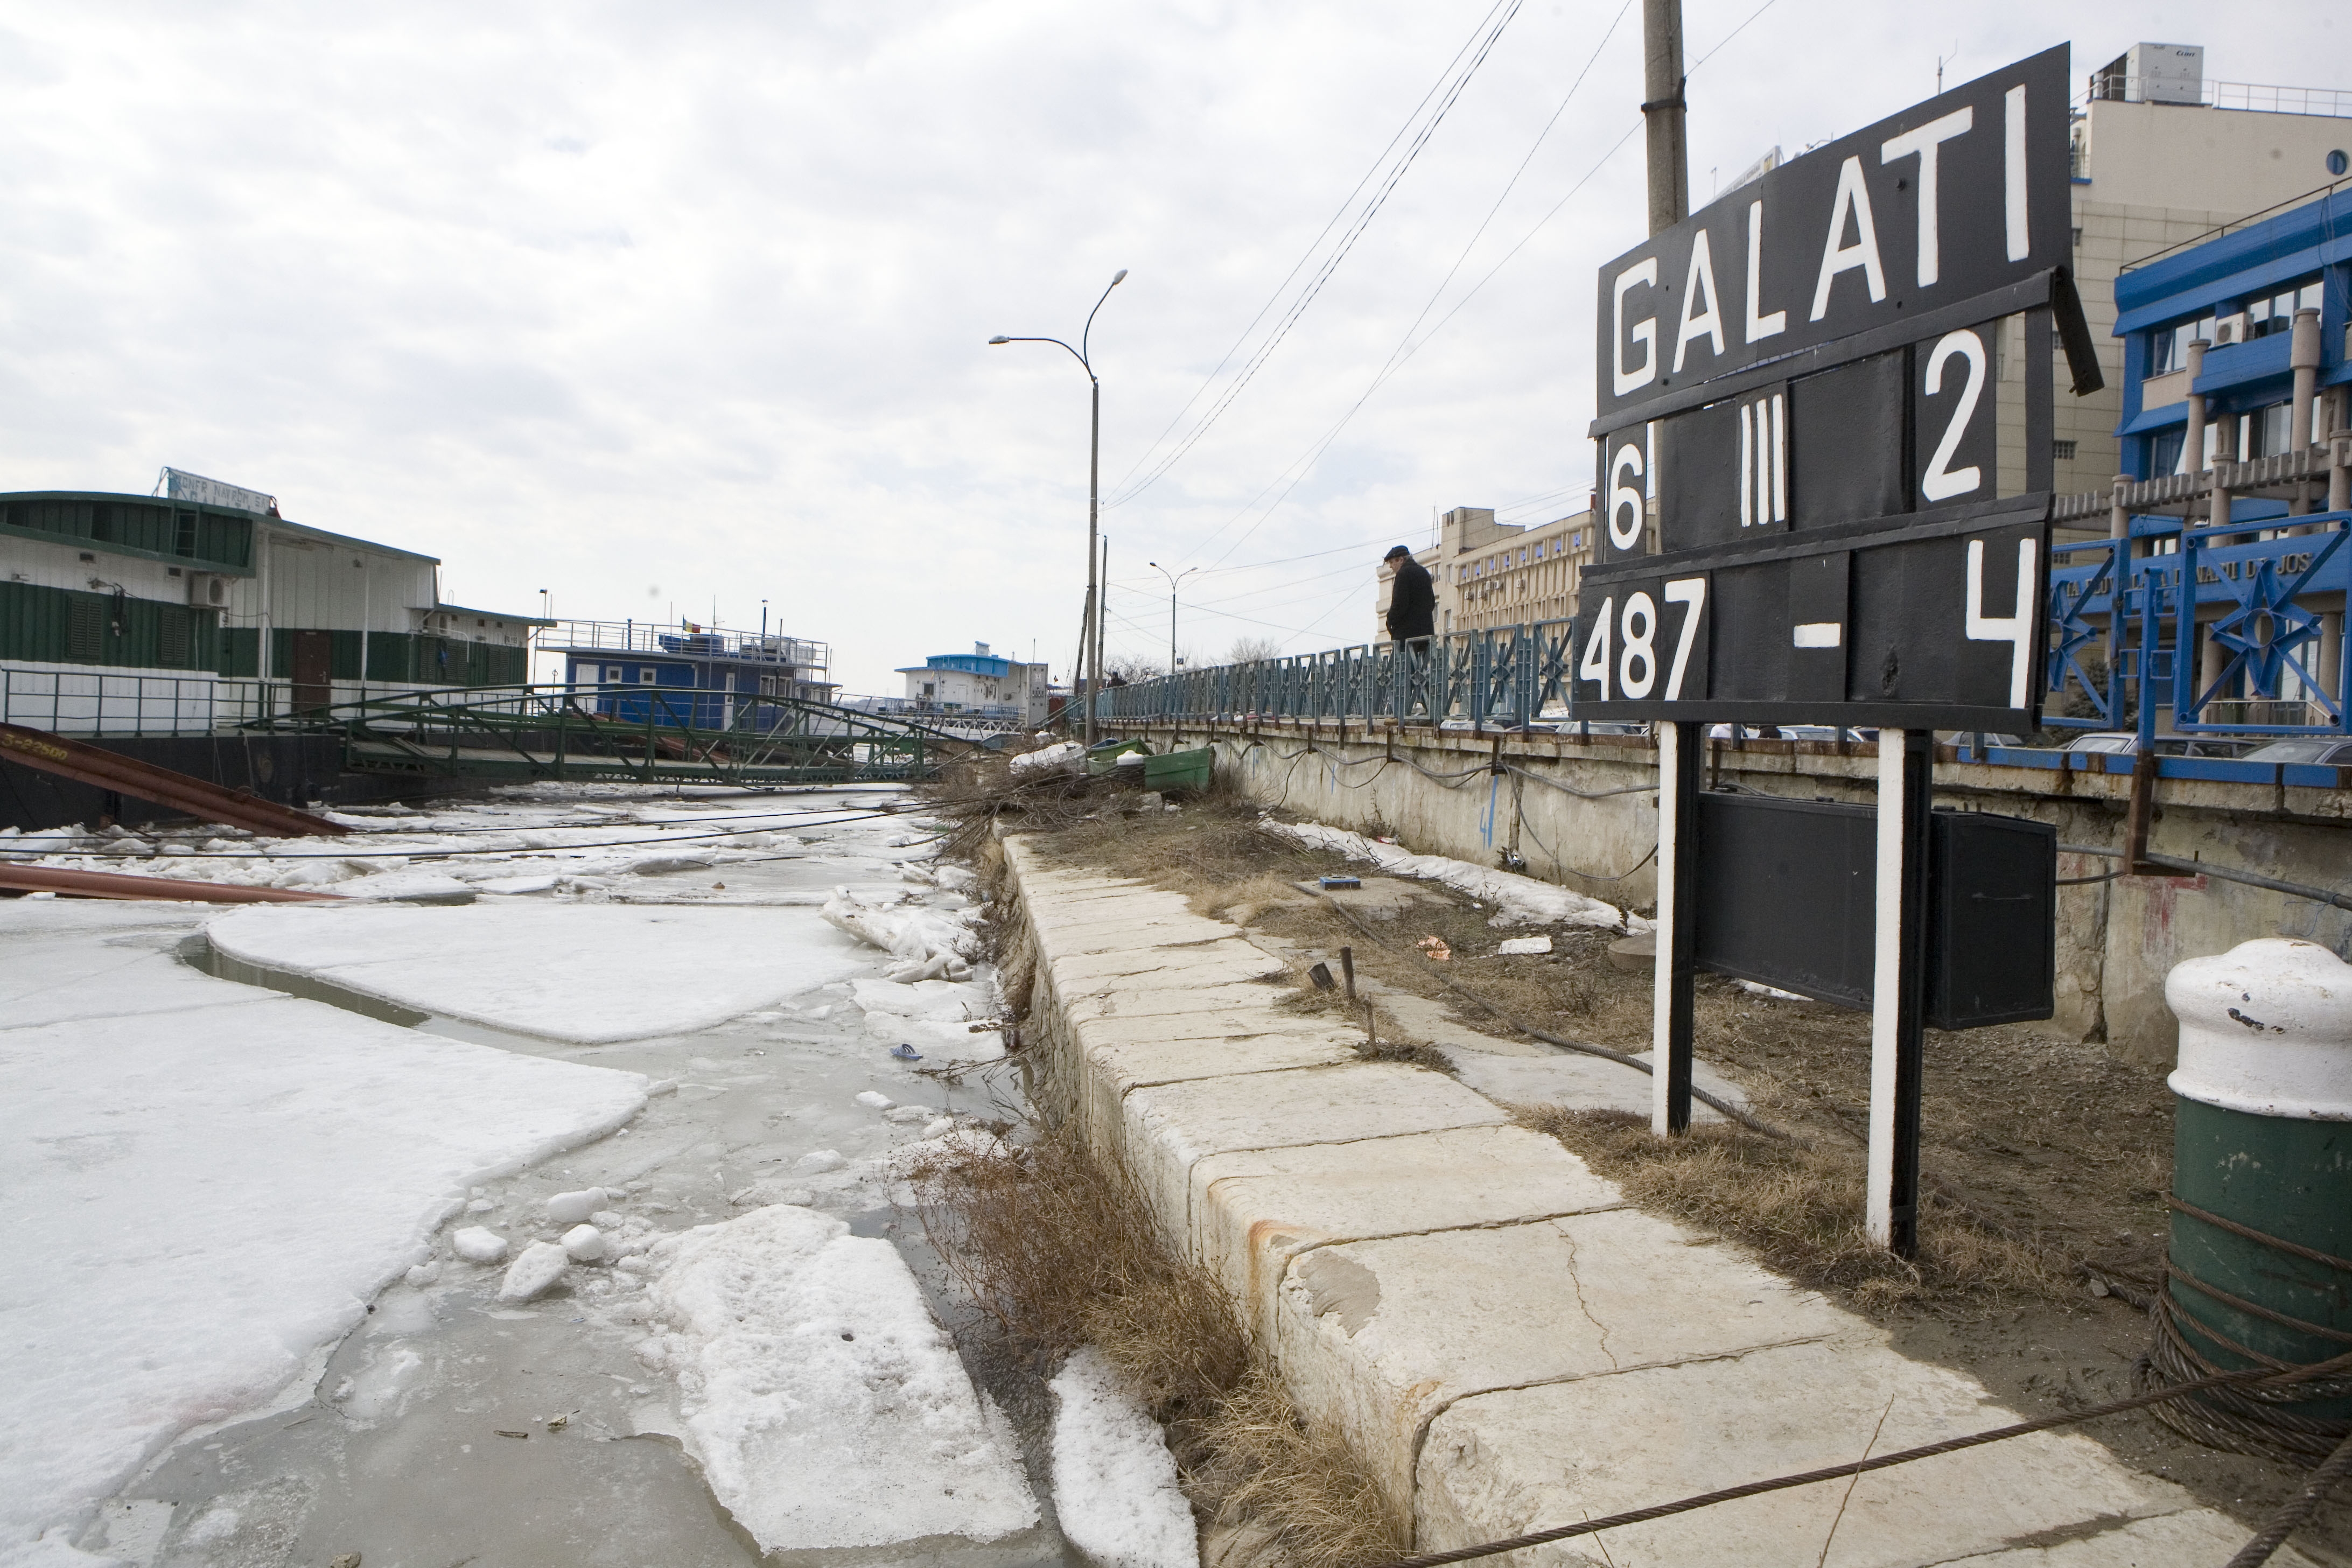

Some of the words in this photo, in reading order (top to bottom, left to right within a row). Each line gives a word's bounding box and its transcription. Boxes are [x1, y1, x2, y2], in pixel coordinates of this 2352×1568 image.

[1613, 84, 2029, 396] GALATI
[1609, 444, 1643, 550] 6
[1922, 329, 1986, 501] 2
[1580, 578, 1705, 701] 487
[1966, 539, 2036, 709] 4
[2276, 552, 2312, 575] JOS
